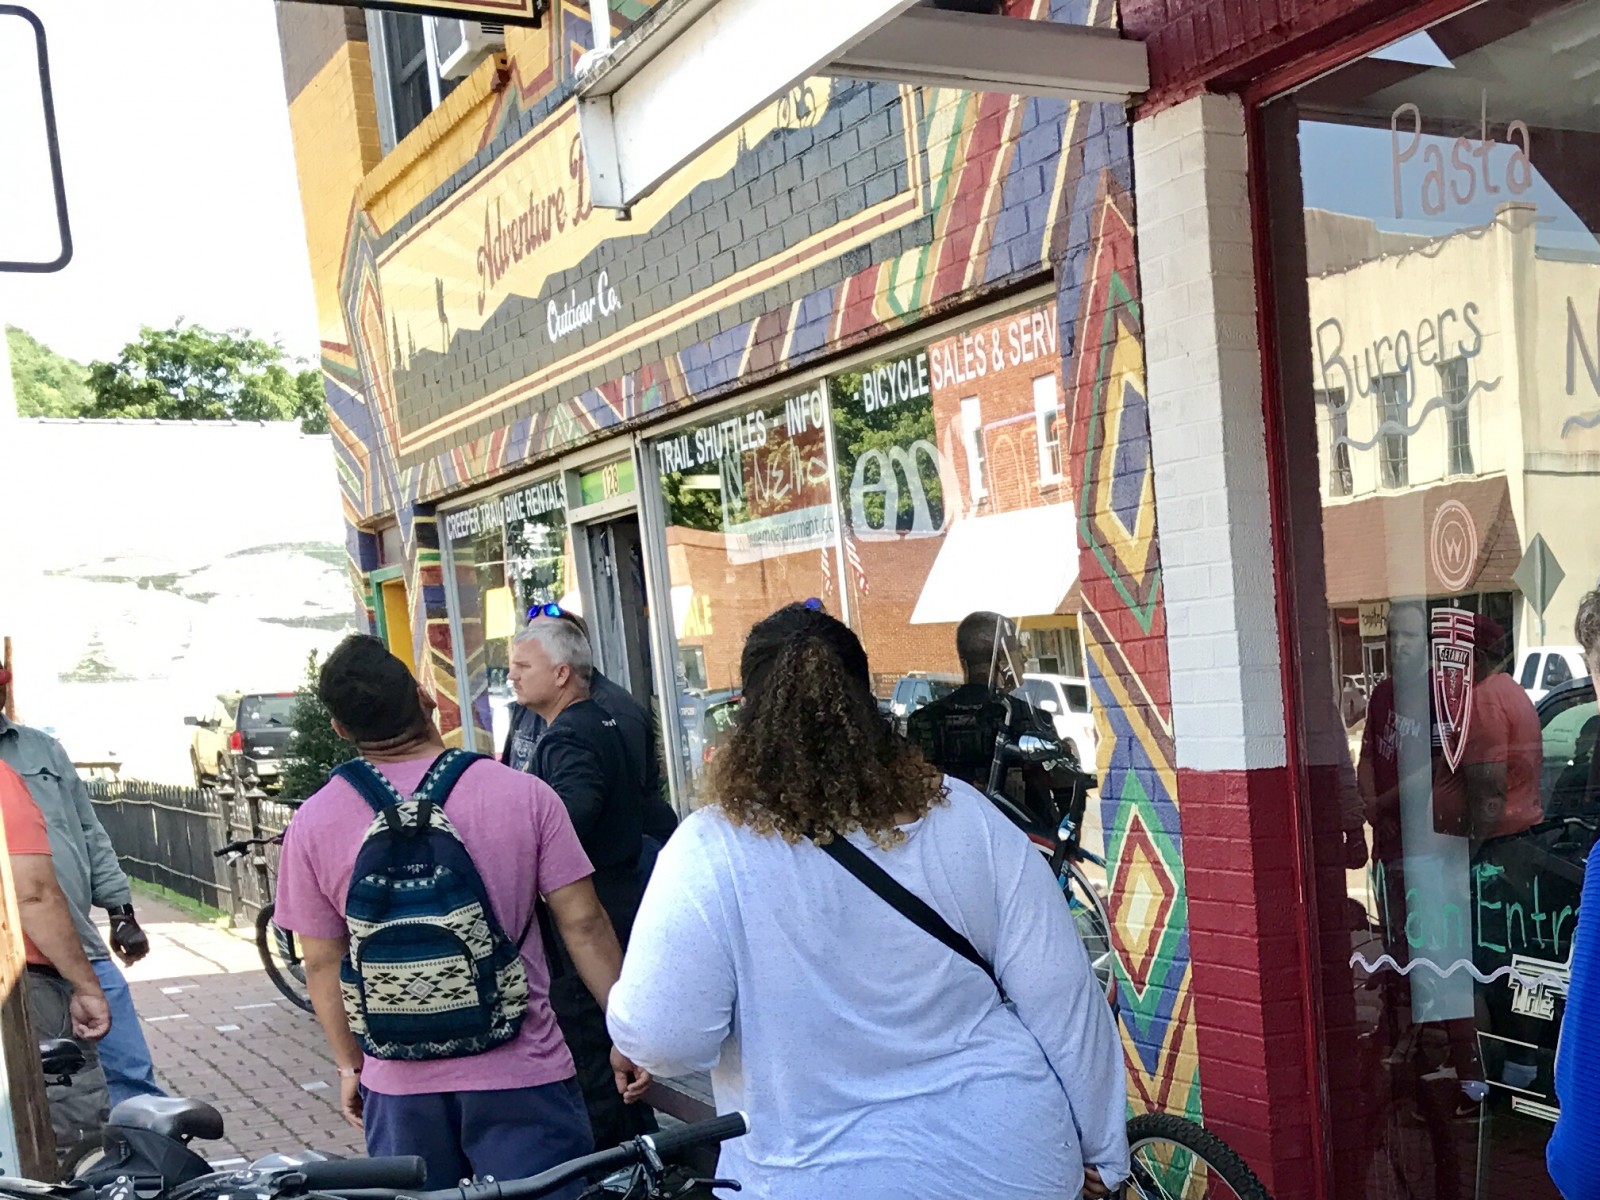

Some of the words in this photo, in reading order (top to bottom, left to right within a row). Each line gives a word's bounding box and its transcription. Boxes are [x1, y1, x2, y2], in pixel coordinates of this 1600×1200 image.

[1391, 88, 1532, 219] Pasta
[477, 186, 567, 316] Adventure
[547, 289, 596, 343] Outdoor
[1316, 302, 1483, 410] Burgers
[863, 352, 930, 413] BICYCLE
[931, 333, 987, 391] SALES
[992, 327, 1005, 372] &
[657, 436, 694, 474] TRAIL
[695, 410, 767, 464] SHUTTLES
[785, 390, 823, 437] INFO
[445, 511, 480, 540] CREEPER
[479, 501, 504, 532] TRAIL
[504, 491, 526, 523] BIKE
[526, 478, 567, 518] RENTALS
[602, 463, 619, 498] 128
[1440, 647, 1469, 665] GETAWAY
